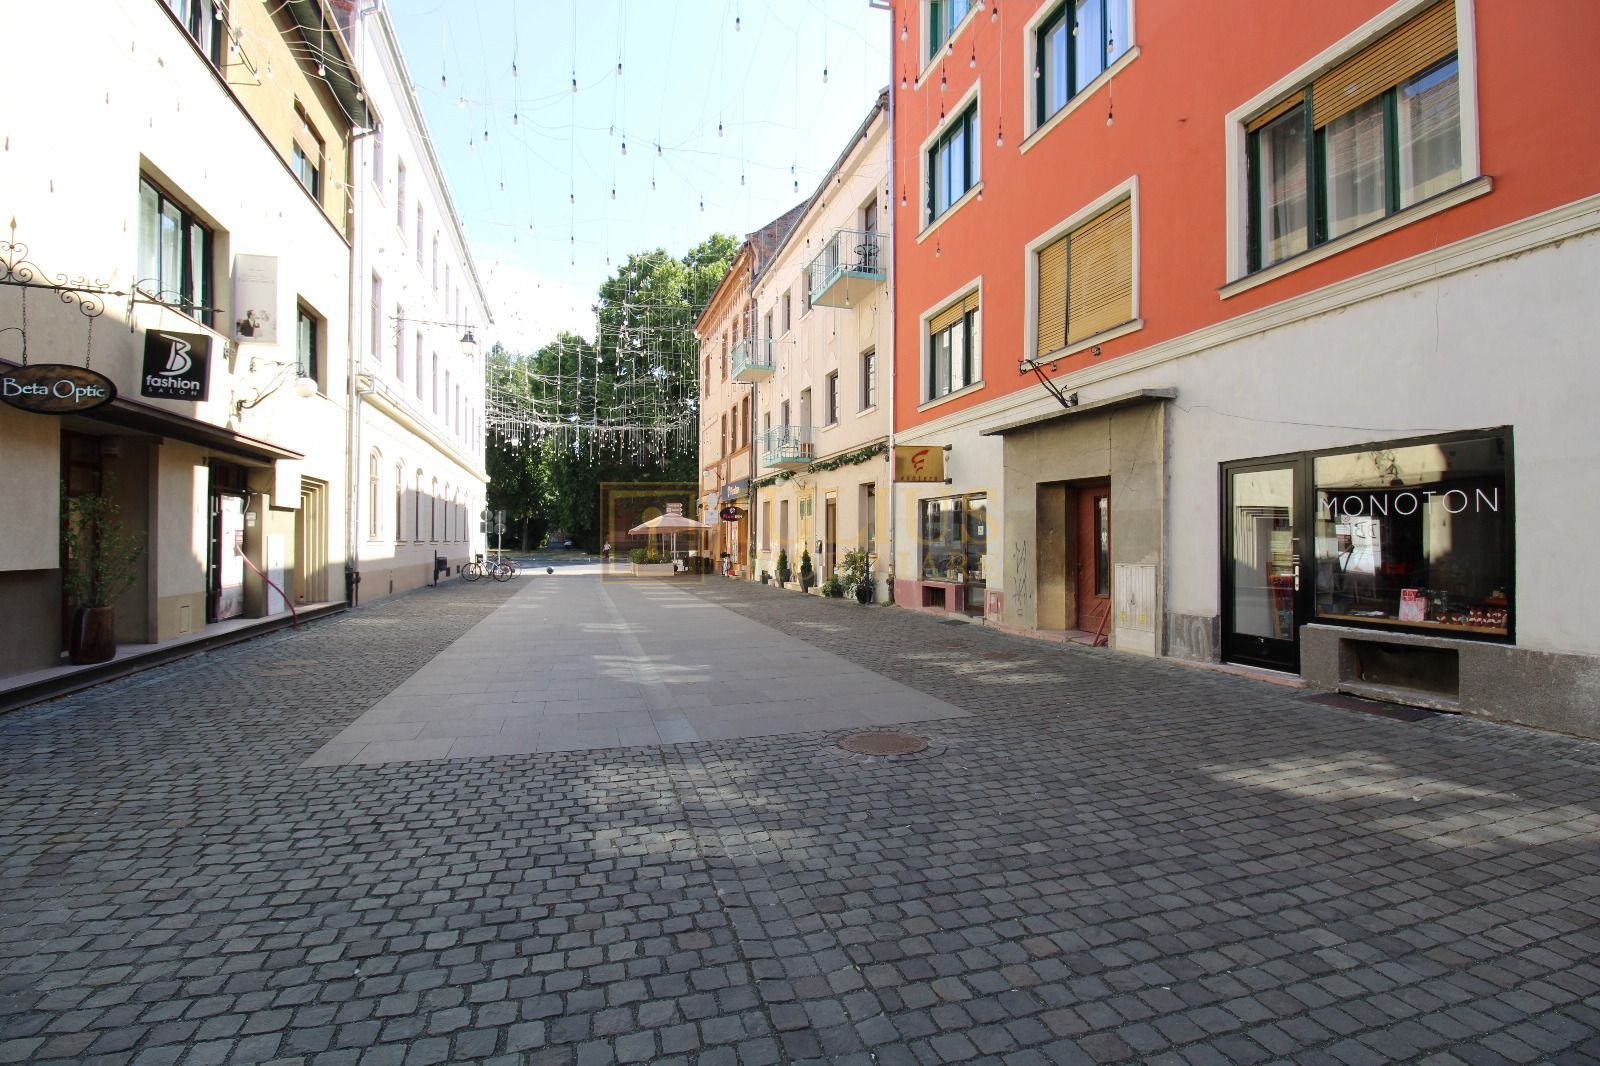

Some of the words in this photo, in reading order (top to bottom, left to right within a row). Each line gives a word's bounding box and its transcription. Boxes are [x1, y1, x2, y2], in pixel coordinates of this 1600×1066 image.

[159, 333, 192, 376] B
[3, 377, 49, 396] Beta
[53, 379, 105, 403] Optic
[146, 375, 200, 390] fashion
[148, 386, 198, 396] SALON
[1321, 487, 1498, 517] MONOTON
